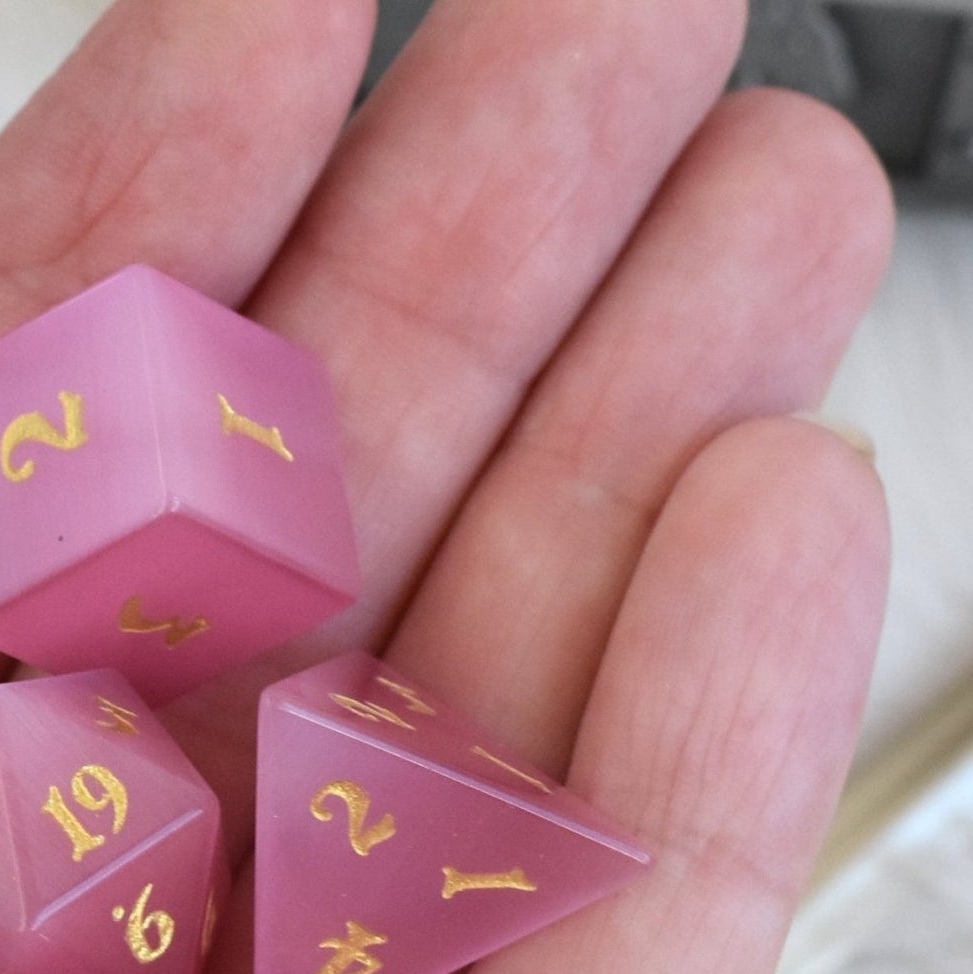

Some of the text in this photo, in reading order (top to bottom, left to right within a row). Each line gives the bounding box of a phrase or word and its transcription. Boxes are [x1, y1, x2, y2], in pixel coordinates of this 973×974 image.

[0, 391, 87, 483] 2
[219, 393, 294, 462] 1
[42, 764, 128, 862] 19
[310, 780, 397, 856] 2
[442, 867, 538, 899] 1
